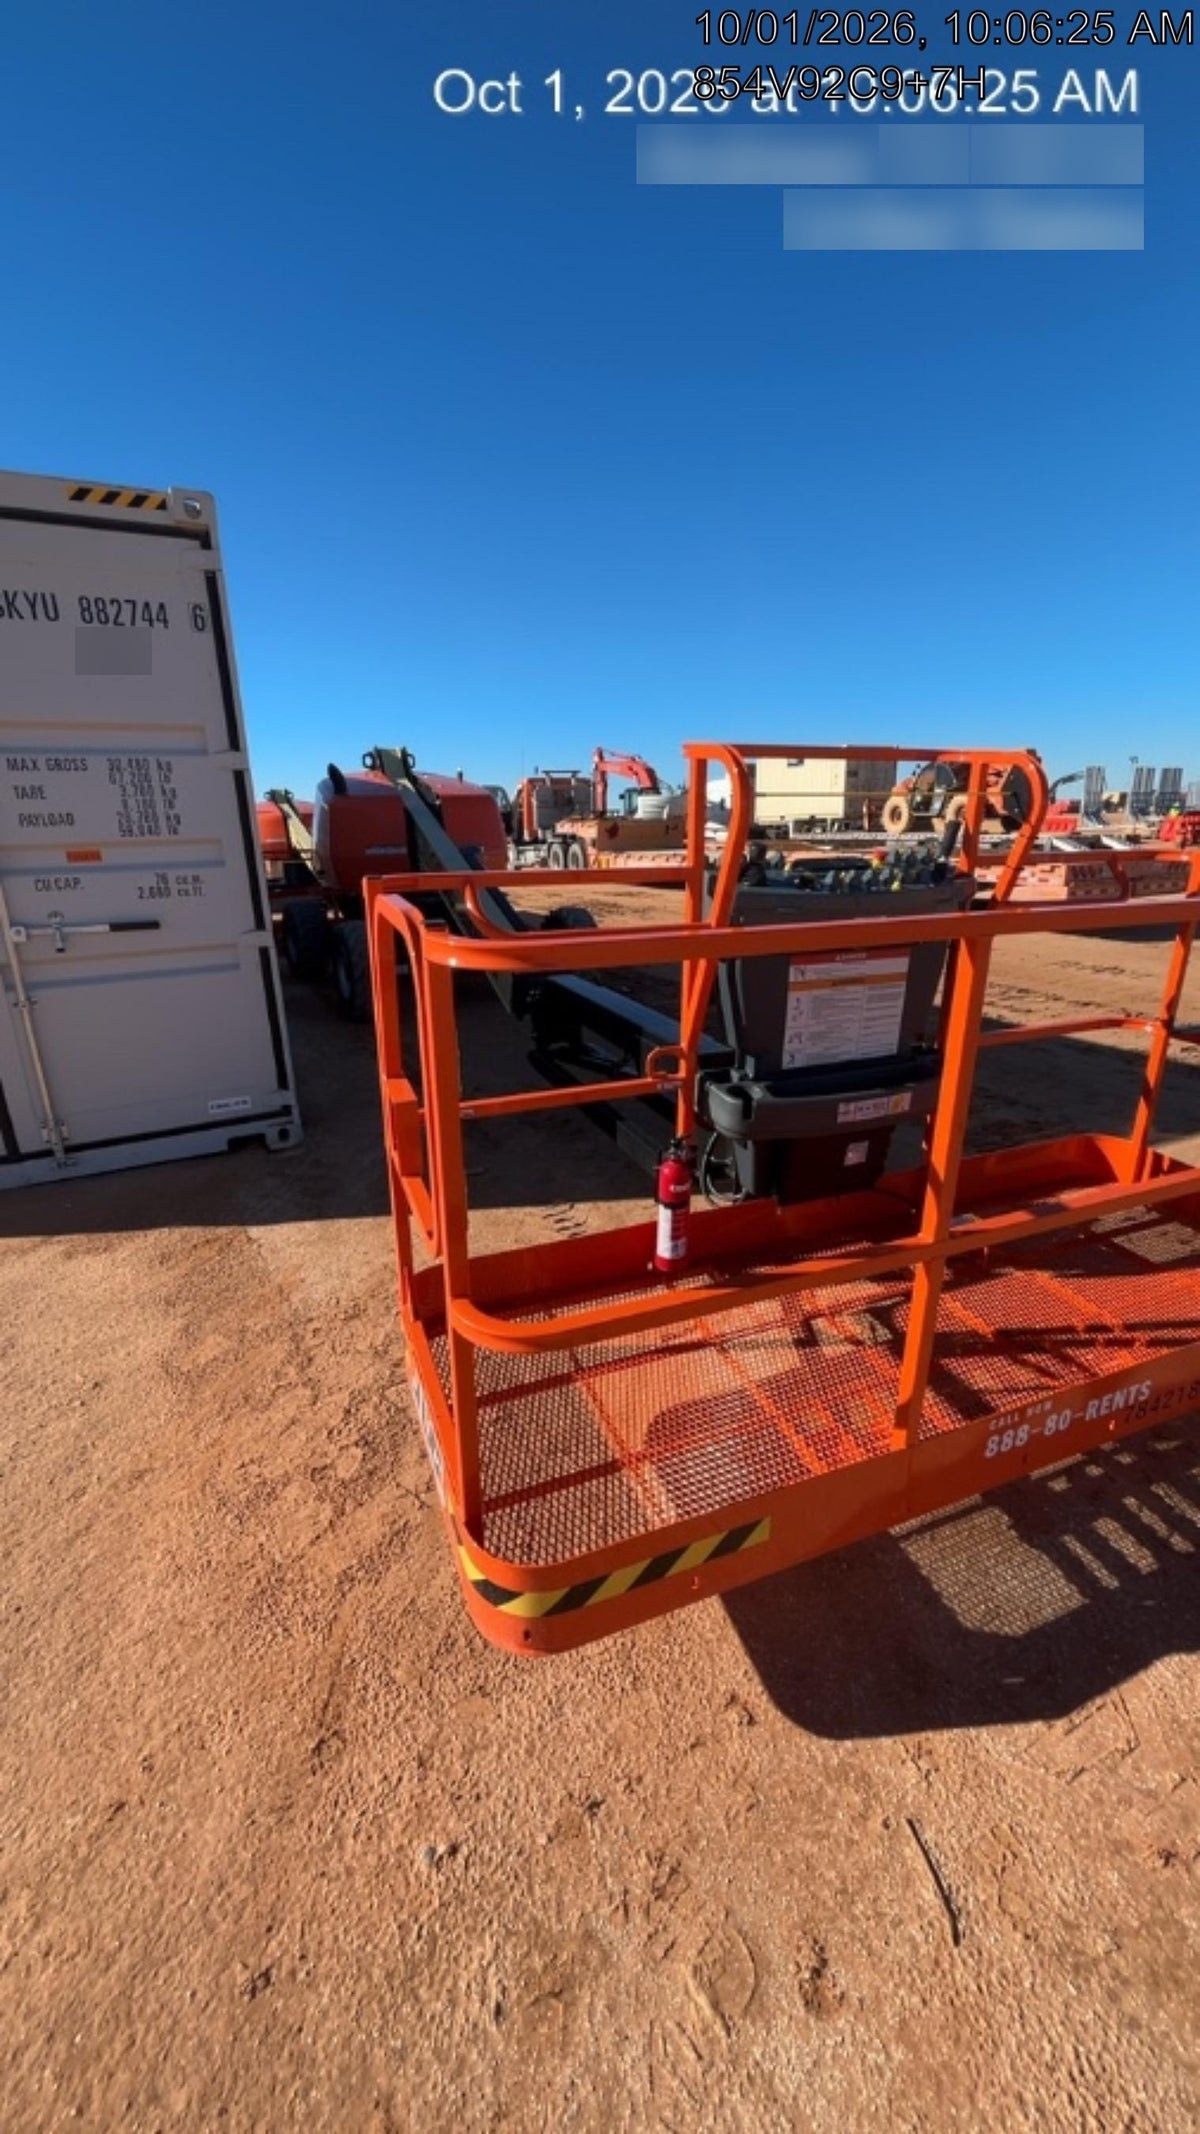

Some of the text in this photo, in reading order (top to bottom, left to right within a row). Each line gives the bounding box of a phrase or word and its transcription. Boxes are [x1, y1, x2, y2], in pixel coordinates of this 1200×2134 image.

[0, 590, 206, 632] KYU 882744 6
[6, 757, 41, 771] MAX
[45, 758, 88, 771] GROSS
[12, 785, 47, 800] TARE
[18, 812, 75, 827] PAYLOAD
[984, 1379, 1152, 1460] 888-80-RENTS
